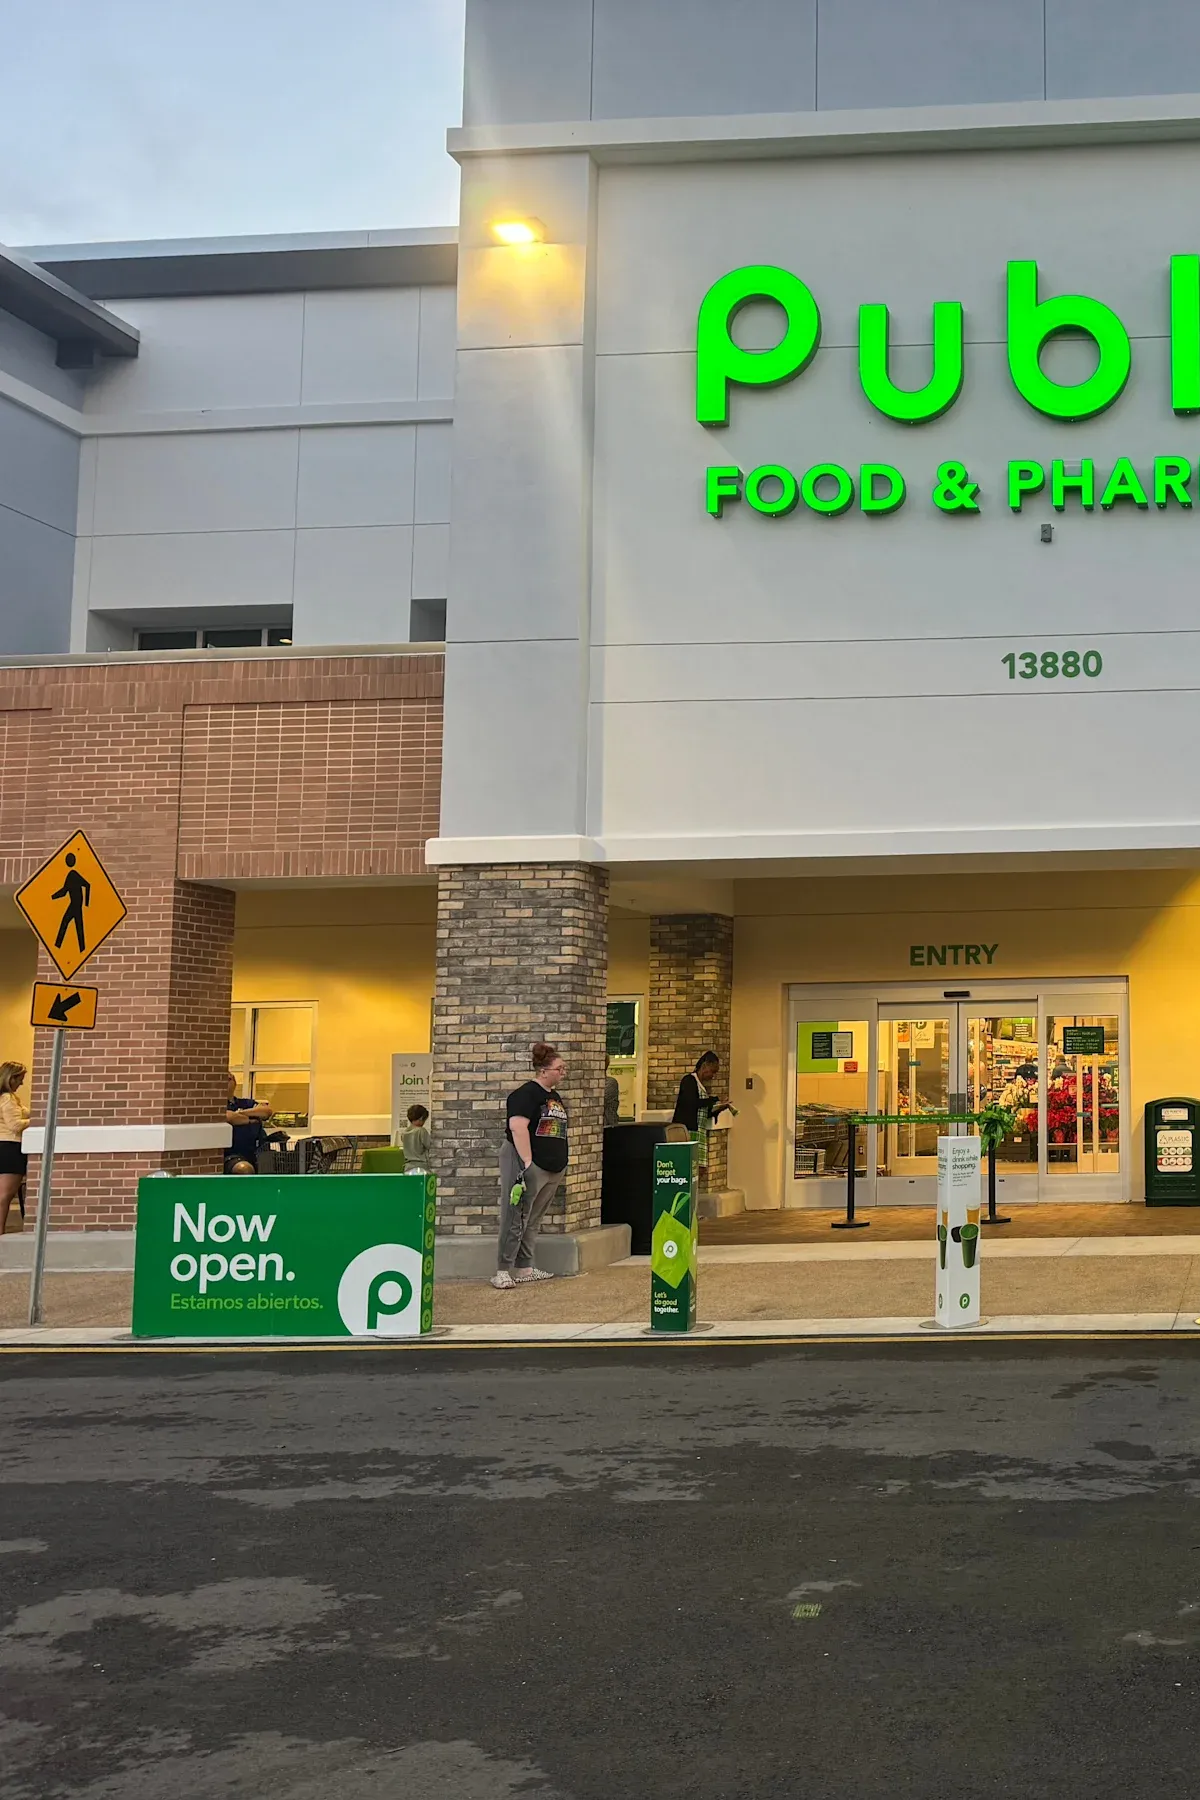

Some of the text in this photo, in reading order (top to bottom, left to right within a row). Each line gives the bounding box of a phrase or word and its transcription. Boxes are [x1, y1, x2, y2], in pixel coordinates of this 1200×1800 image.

[705, 462, 906, 518] FOOD
[931, 459, 980, 514] &
[1001, 650, 1103, 680] 13880
[909, 943, 999, 967] ENTRY
[400, 1074, 424, 1086] Join
[952, 1147, 966, 1157] Enjoy
[656, 1160, 673, 1168] Don't
[656, 1168, 676, 1177] forget
[656, 1175, 688, 1185] your bags.
[173, 1203, 277, 1243] Now
[170, 1252, 296, 1294] open.
[654, 1291, 667, 1299] Let's
[170, 1292, 324, 1310] Estamos abiertos.
[662, 1298, 678, 1306] good
[653, 1306, 680, 1315] together.
